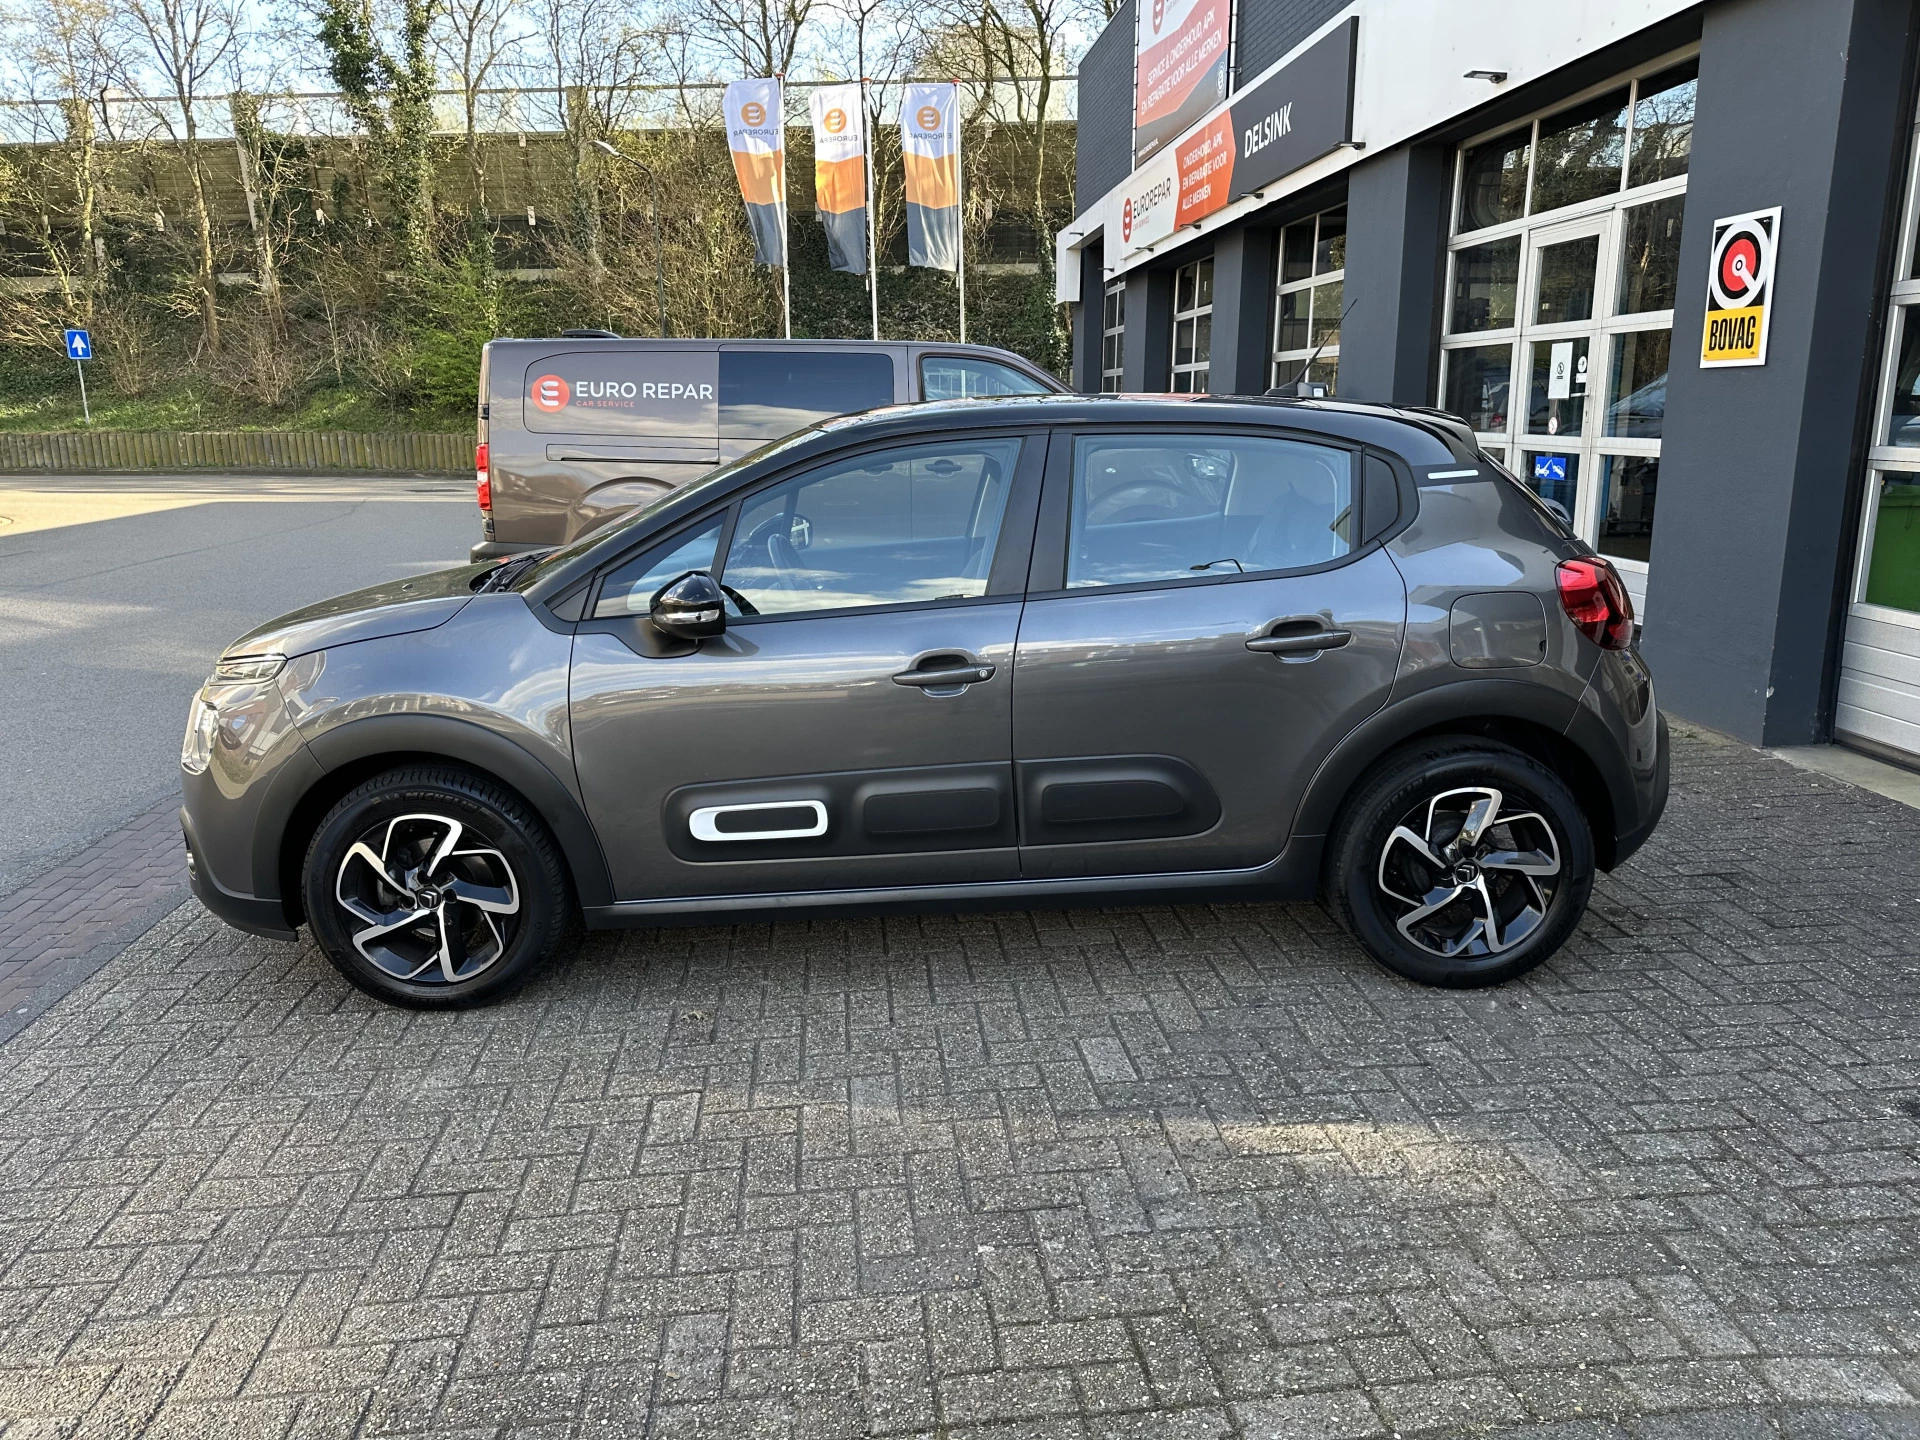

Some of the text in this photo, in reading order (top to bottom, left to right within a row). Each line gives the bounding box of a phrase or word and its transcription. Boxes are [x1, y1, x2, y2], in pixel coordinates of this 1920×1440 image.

[1203, 6, 1215, 32] APK
[1171, 62, 1185, 87] VOOR
[1185, 49, 1198, 75] ALLE
[1199, 26, 1222, 63] MERKEN
[1212, 130, 1223, 149] APK
[1245, 101, 1292, 158] DELSINK
[1182, 174, 1189, 191] EN
[1212, 151, 1227, 173] VOOR
[1133, 177, 1171, 219] EUROREPAR
[1708, 315, 1756, 351] BOVAG
[576, 381, 713, 400] EURO REPAR
[576, 400, 594, 408] CAR
